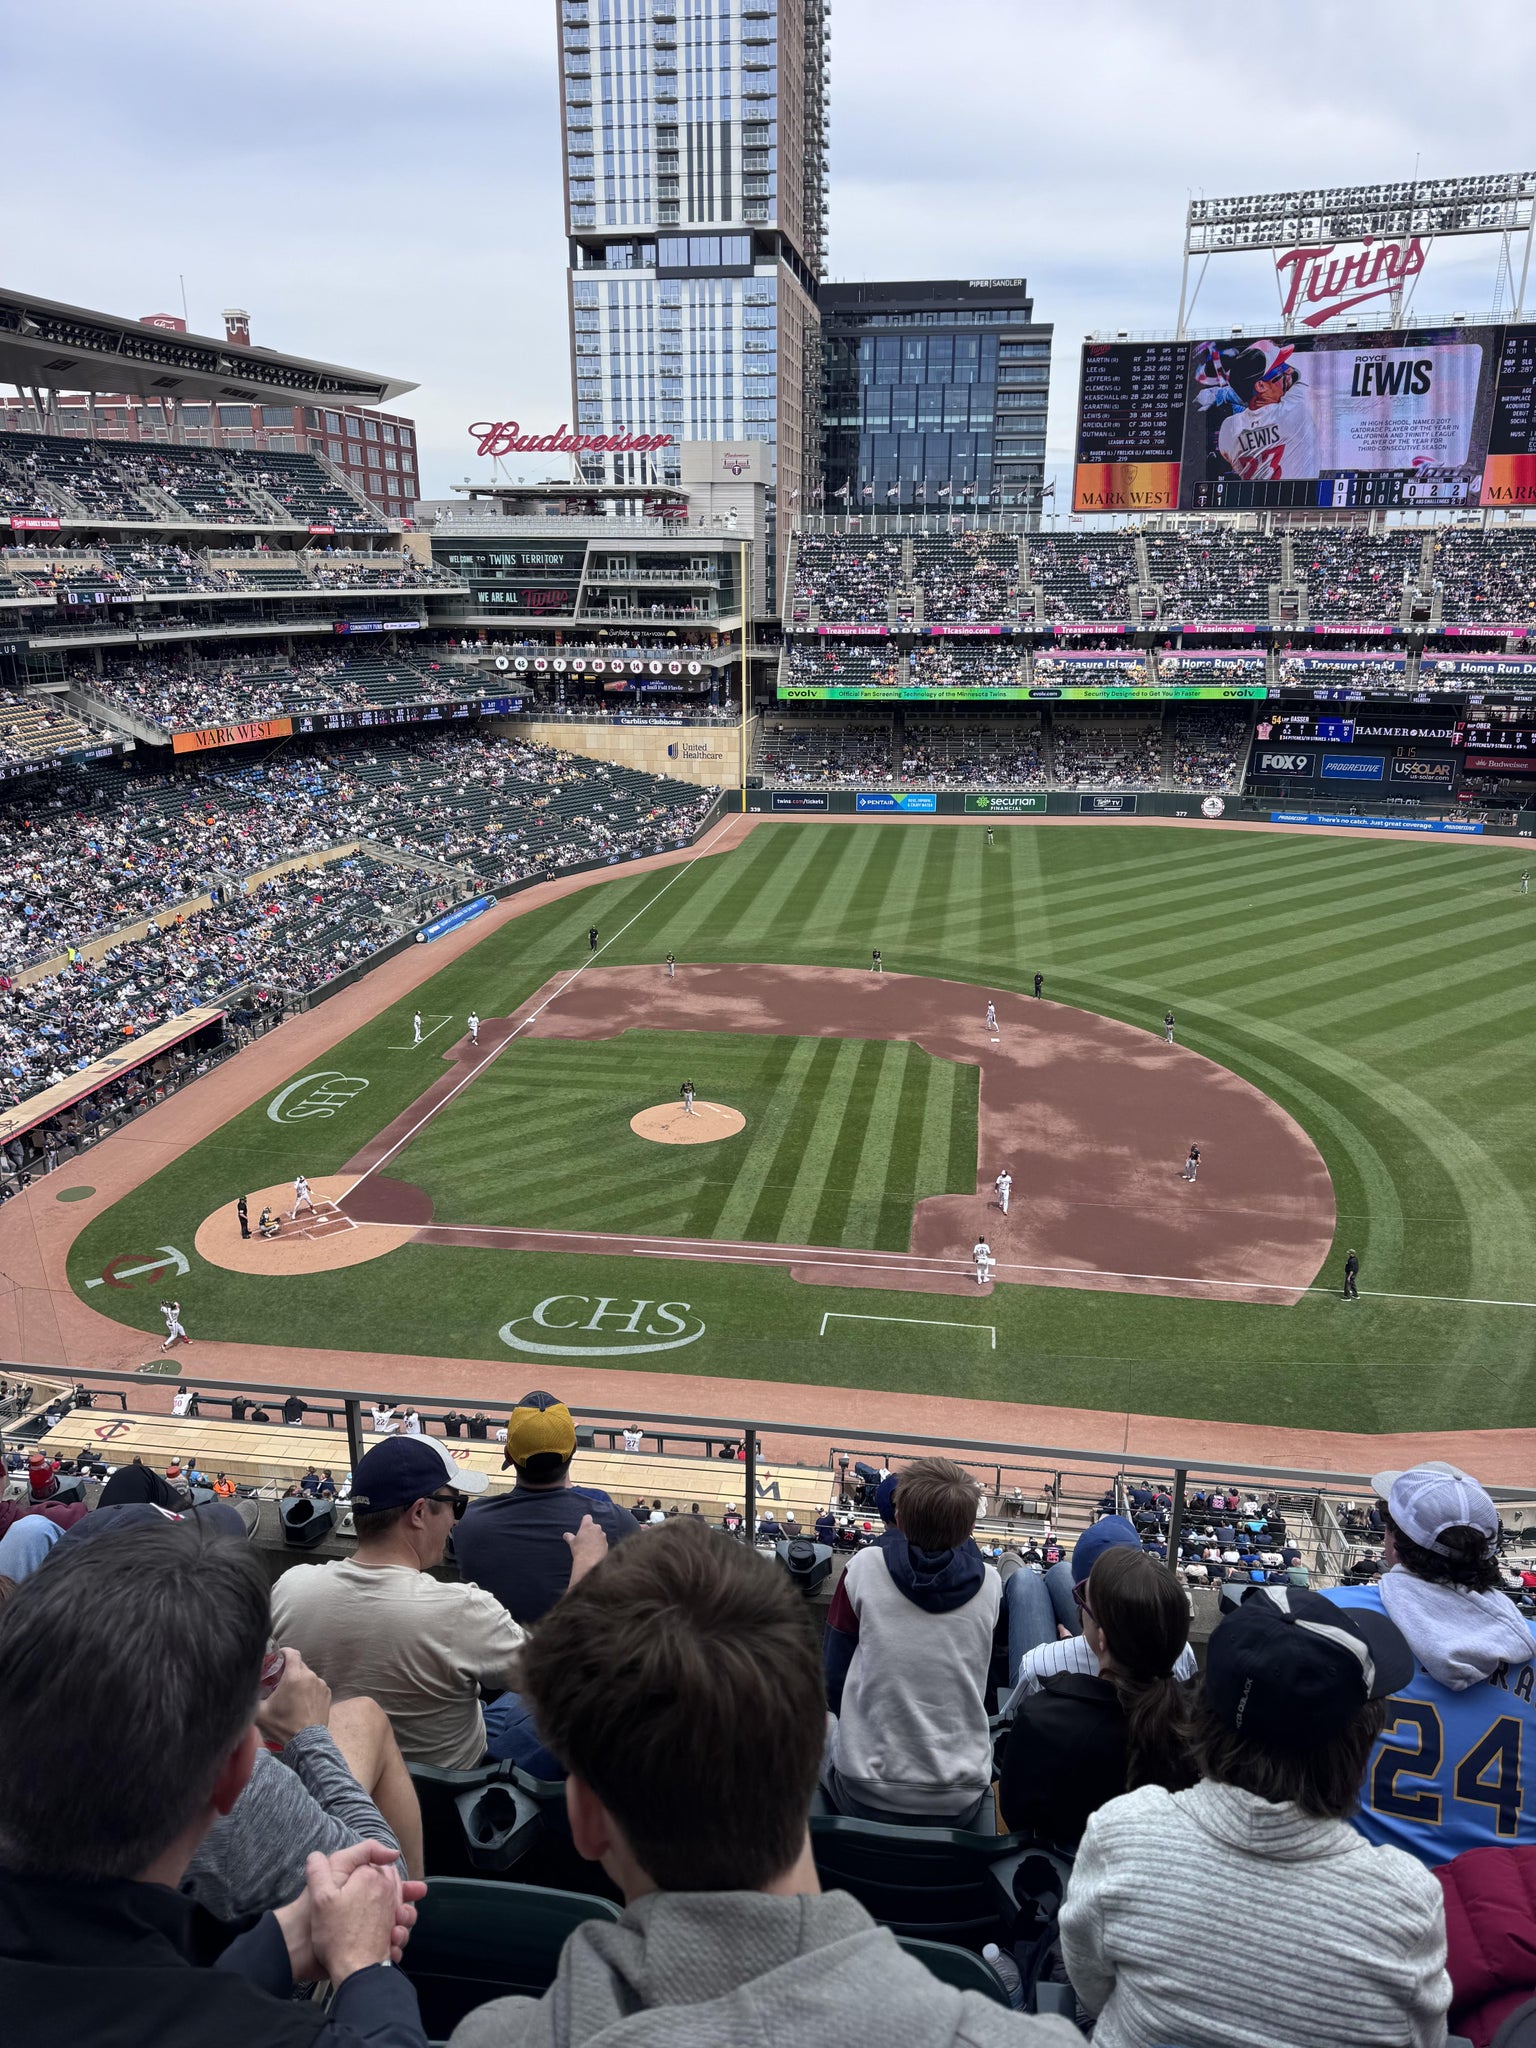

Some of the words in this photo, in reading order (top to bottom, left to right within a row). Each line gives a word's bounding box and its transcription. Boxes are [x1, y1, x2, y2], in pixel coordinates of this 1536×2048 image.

[969, 279, 988, 288] PIPER
[992, 279, 1022, 287] SANDLER
[1276, 235, 1424, 328] Twins
[1351, 360, 1432, 397] LEWIS
[468, 421, 673, 456] Budweiser
[1238, 425, 1280, 452] LEWIS
[1217, 484, 1223, 493] 0
[1338, 482, 1343, 491] 0
[1353, 482, 1357, 491] 1
[1366, 482, 1372, 490] 0
[1394, 481, 1400, 490] 3
[1409, 486, 1416, 496] 0
[1430, 485, 1438, 496] 2
[1452, 485, 1460, 496] 2
[1081, 492, 1128, 504] MARK
[1130, 492, 1171, 504] WEST
[1337, 495, 1342, 504] 1
[1351, 495, 1356, 504] 1
[1365, 495, 1370, 503] 0
[1378, 495, 1384, 503] 0
[1392, 495, 1398, 503] 4
[449, 555, 473, 563] WELCOME
[489, 554, 516, 565] TWINS
[521, 554, 564, 564] TERRITORY
[478, 592, 489, 602] WE
[491, 592, 504, 602] ARE
[506, 592, 518, 602] ALL
[521, 589, 569, 615] Twins
[613, 662, 622, 670] 34
[693, 664, 697, 672] 3
[1461, 663, 1494, 673] Home
[1497, 664, 1520, 673] Run
[649, 718, 682, 726] Clubhouse
[1272, 716, 1281, 724] 54
[1457, 722, 1465, 730] 17
[195, 727, 235, 747] MARK
[238, 722, 272, 740] WEST
[1355, 726, 1409, 737] HAMMER
[1418, 729, 1452, 739] MADE
[682, 743, 707, 751] United
[683, 751, 723, 759] Healthcare
[1262, 755, 1294, 770] FOX
[1296, 756, 1307, 770] 9
[1325, 763, 1380, 772] PROGRESSIVE
[1488, 760, 1529, 769] Budweiser
[990, 797, 1035, 806] securian
[532, 1294, 694, 1336] CHS
[1371, 1696, 1524, 1838] 24
